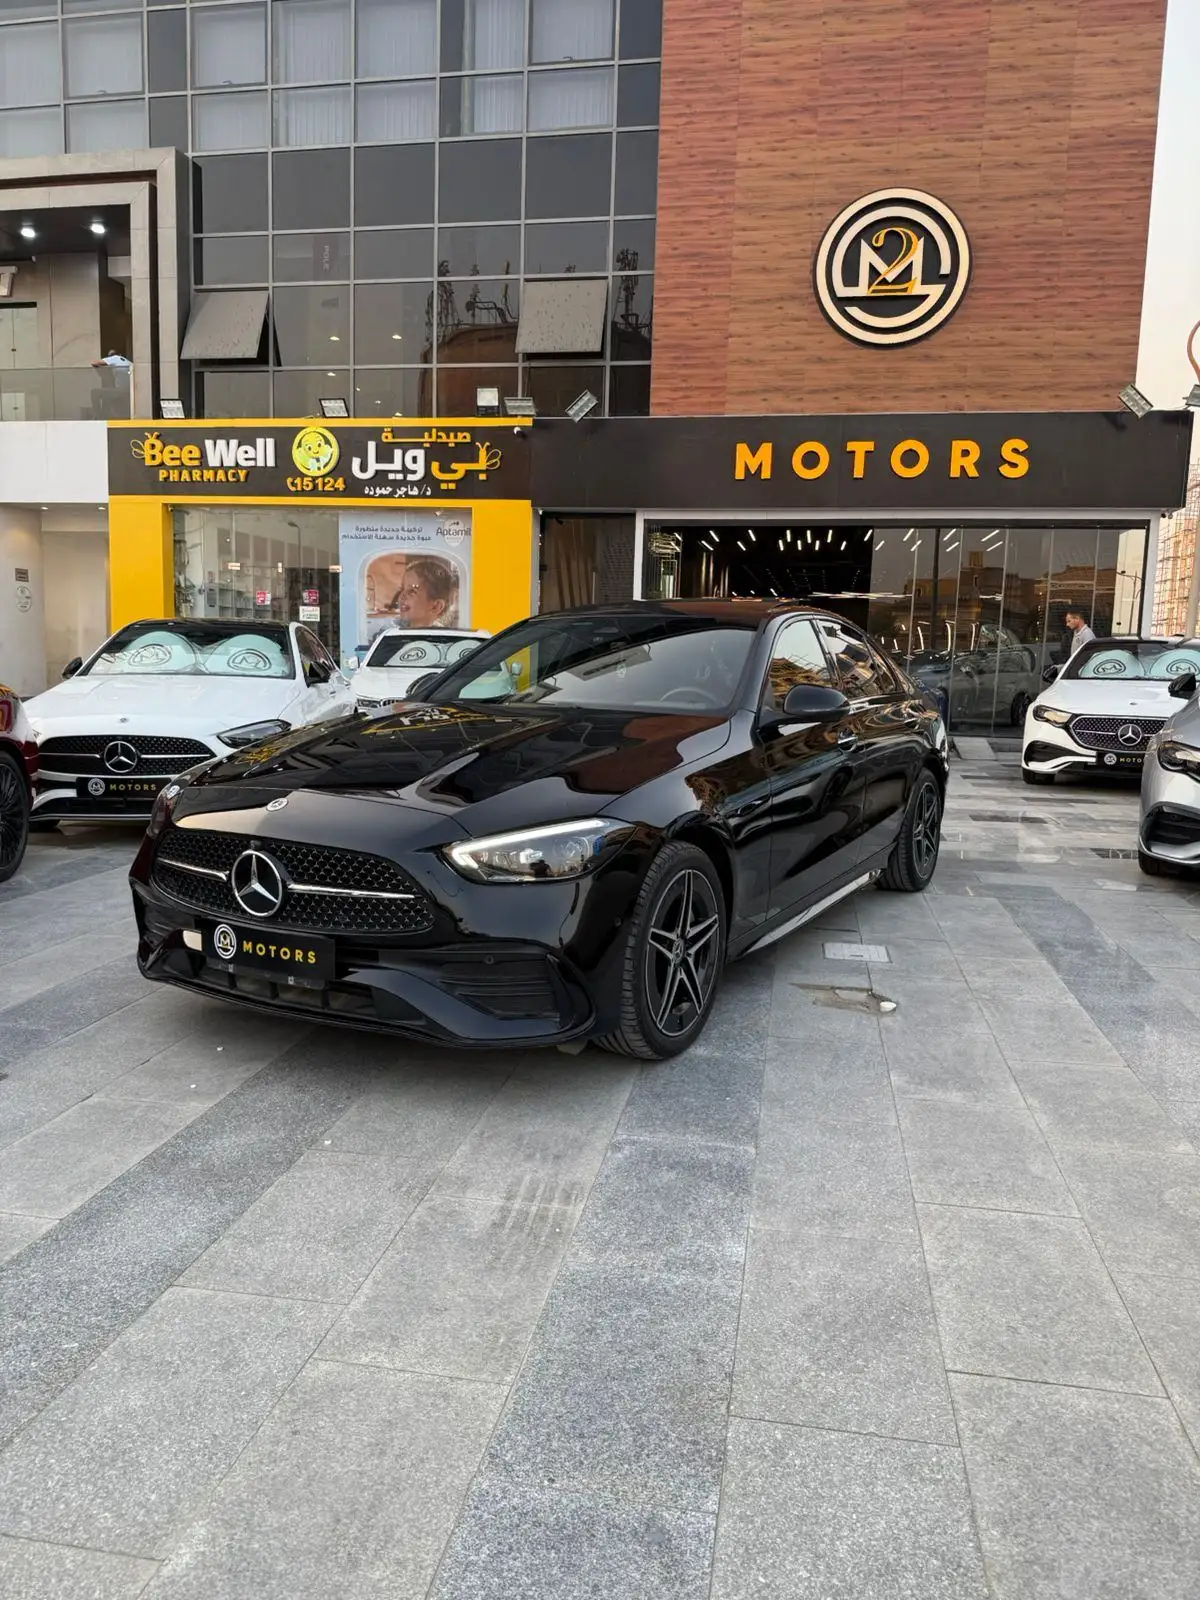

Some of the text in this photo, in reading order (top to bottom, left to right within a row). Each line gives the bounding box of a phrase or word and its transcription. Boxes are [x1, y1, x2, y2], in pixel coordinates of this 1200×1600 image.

[381, 427, 472, 447] صيدلية
[144, 437, 276, 467] Bee Well
[734, 438, 1030, 480] MOTORS
[158, 469, 249, 483] PHARMACY
[351, 440, 488, 490] بي ويل
[109, 783, 157, 791] MOTORS
[242, 940, 317, 964] MOTORS
